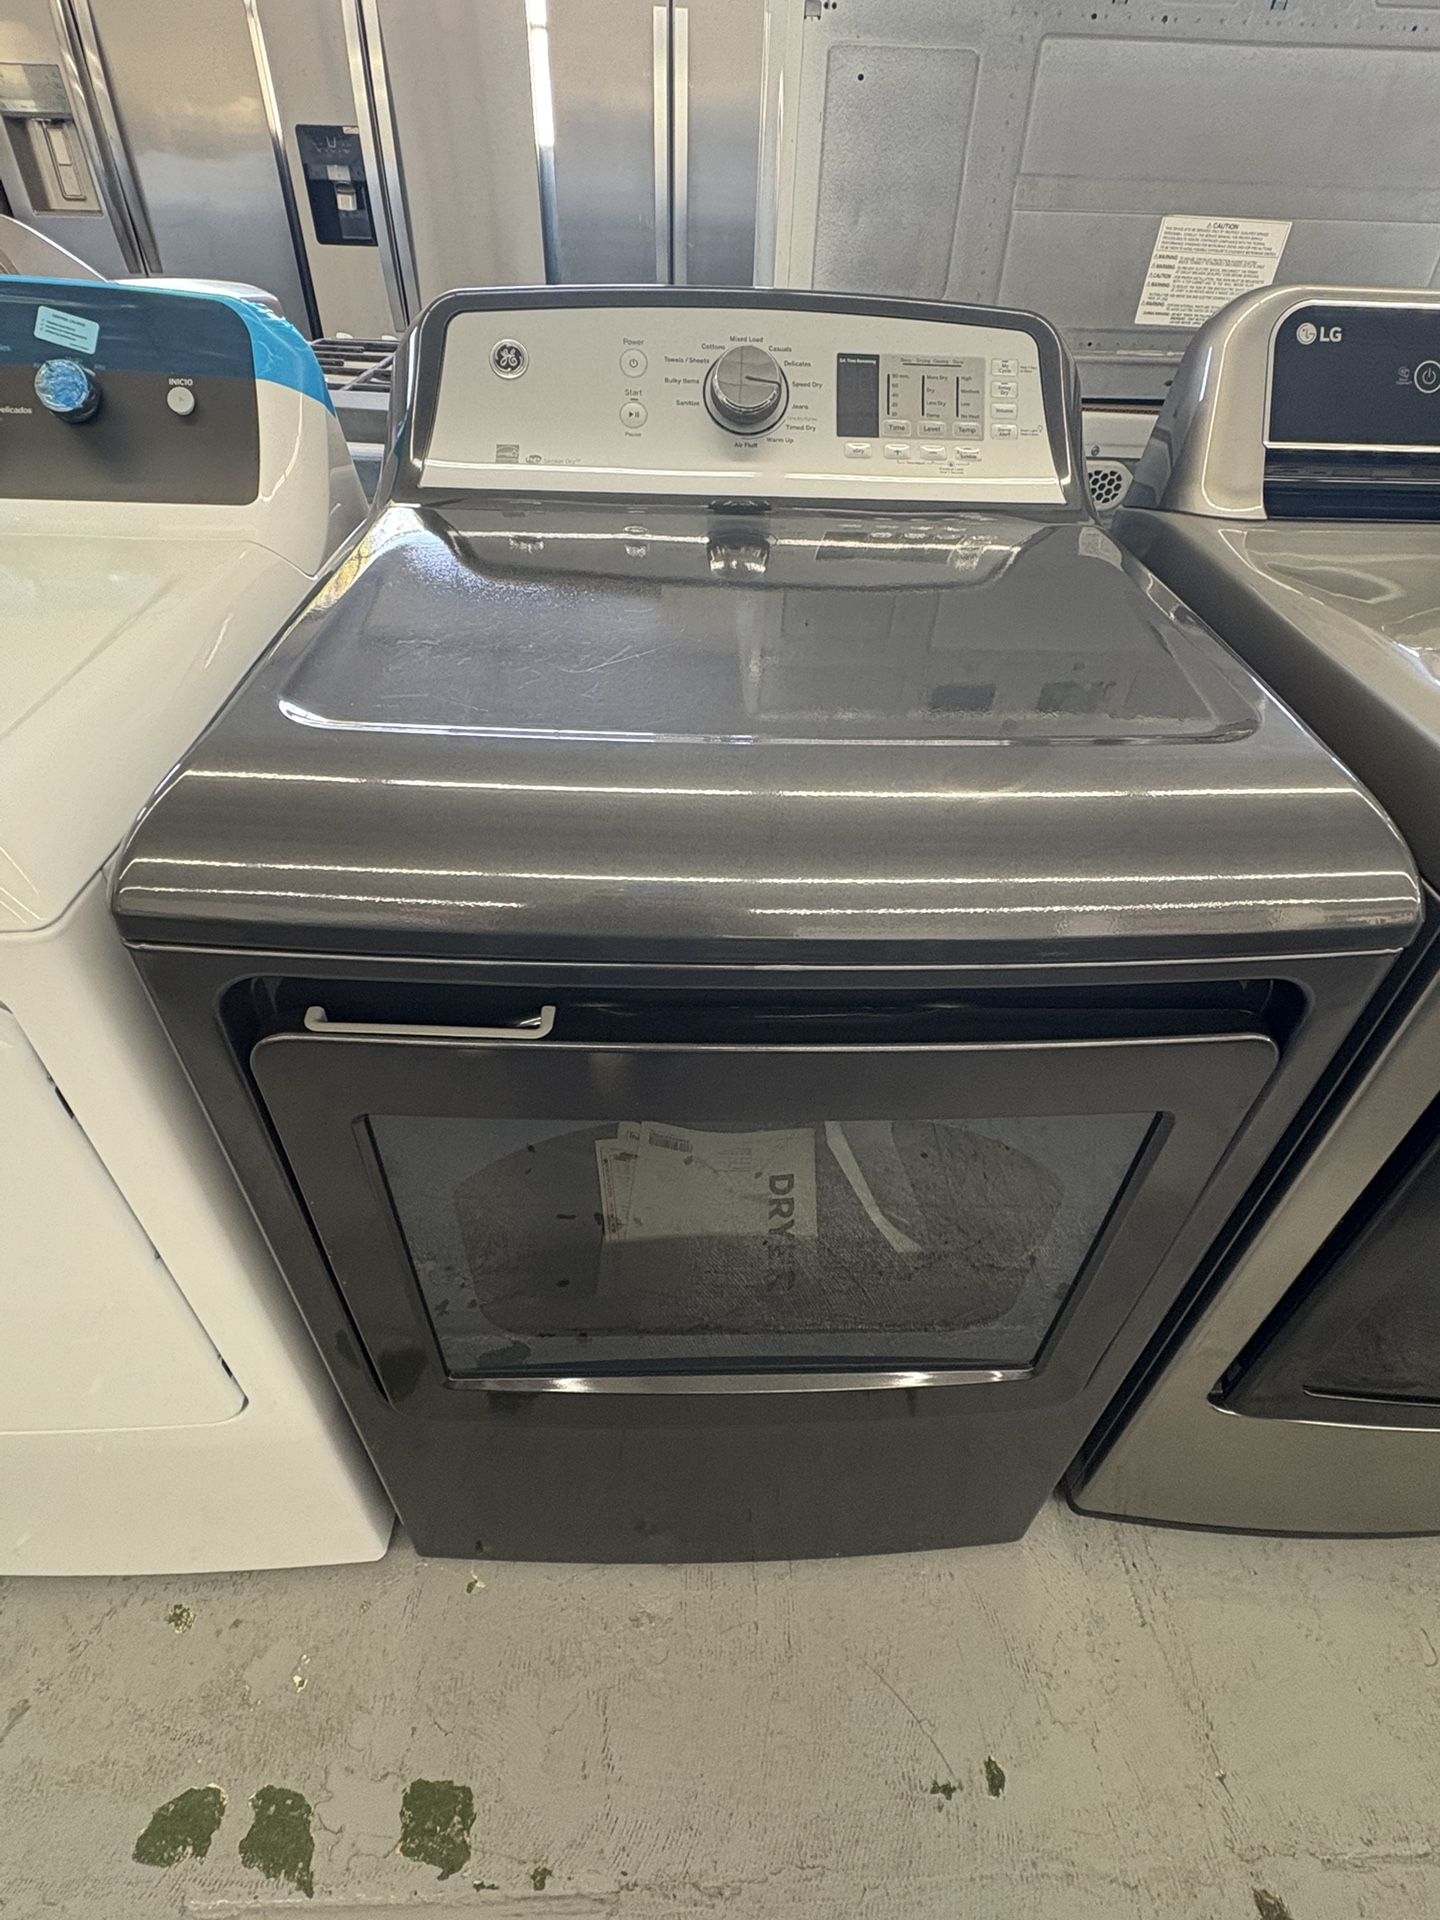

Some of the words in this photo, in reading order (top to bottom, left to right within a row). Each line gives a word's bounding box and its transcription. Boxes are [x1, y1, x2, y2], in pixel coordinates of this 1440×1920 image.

[1320, 326, 1342, 342] LG
[623, 338, 644, 346] Power
[664, 356, 685, 364] Towels
[689, 357, 710, 365] Sheets
[168, 378, 193, 387] INICIO
[664, 377, 682, 385] Bulky
[792, 381, 809, 389] Speed
[810, 381, 823, 389] Dry
[625, 388, 643, 396] Start
[0, 405, 33, 415] elicados
[805, 424, 816, 433] Dry
[958, 426, 977, 434] Temp
[784, 437, 794, 445] Up
